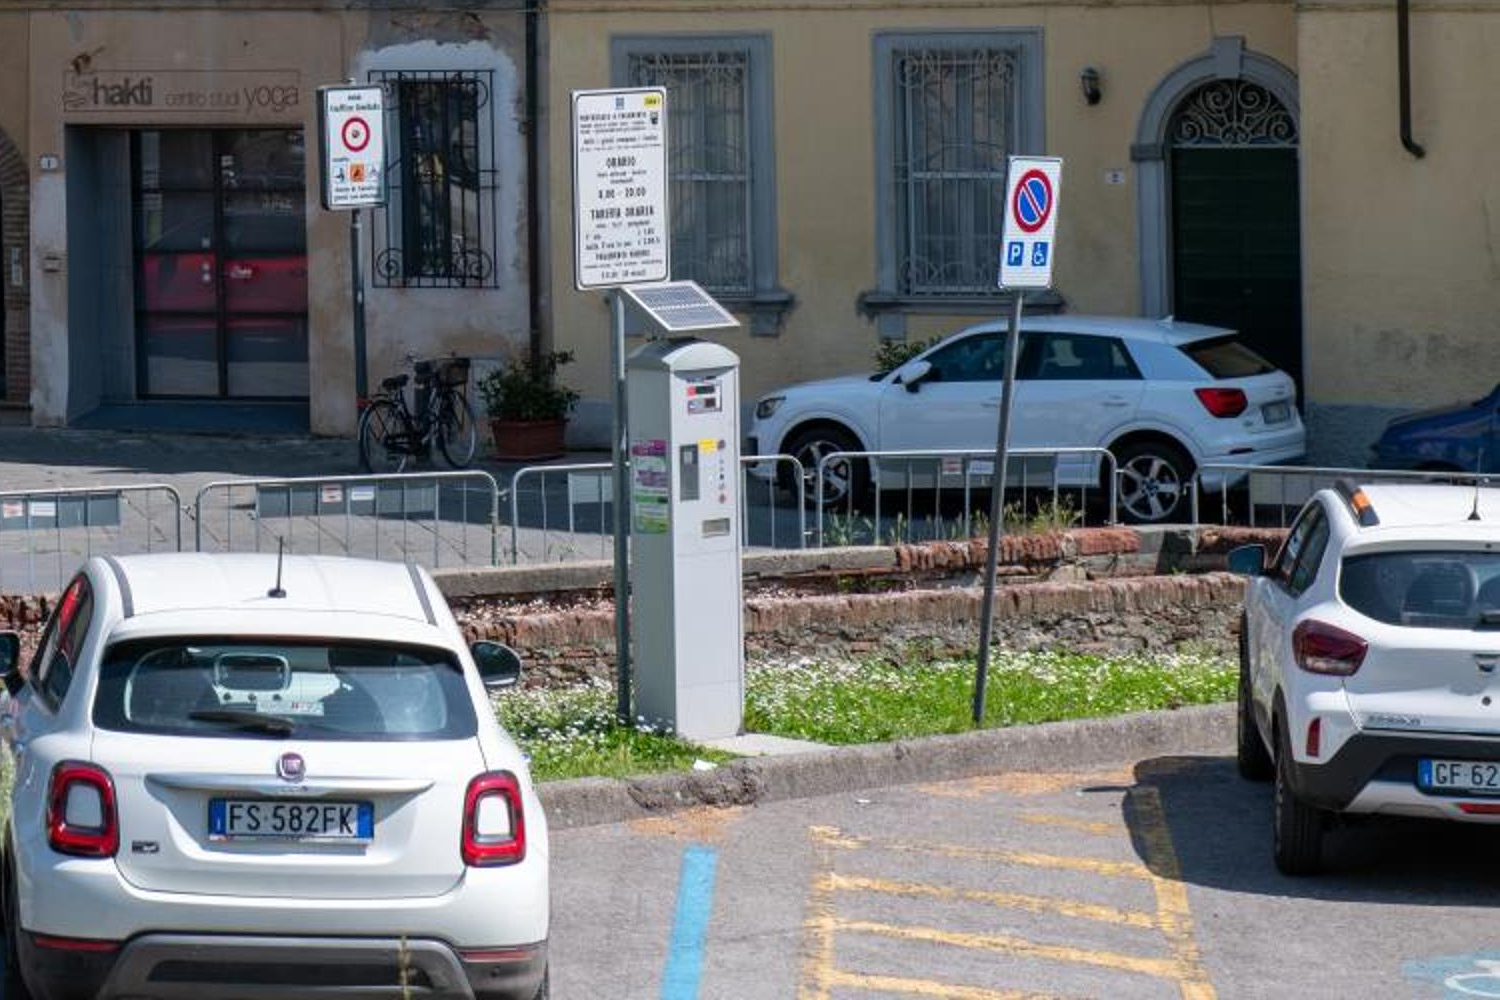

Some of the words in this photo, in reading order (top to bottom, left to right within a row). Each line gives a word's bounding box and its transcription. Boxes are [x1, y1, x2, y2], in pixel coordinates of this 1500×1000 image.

[244, 86, 299, 114] yoga
[1011, 244, 1021, 263] P
[1436, 762, 1462, 785] GF
[230, 804, 261, 832] FS
[272, 804, 354, 834] 582FK
